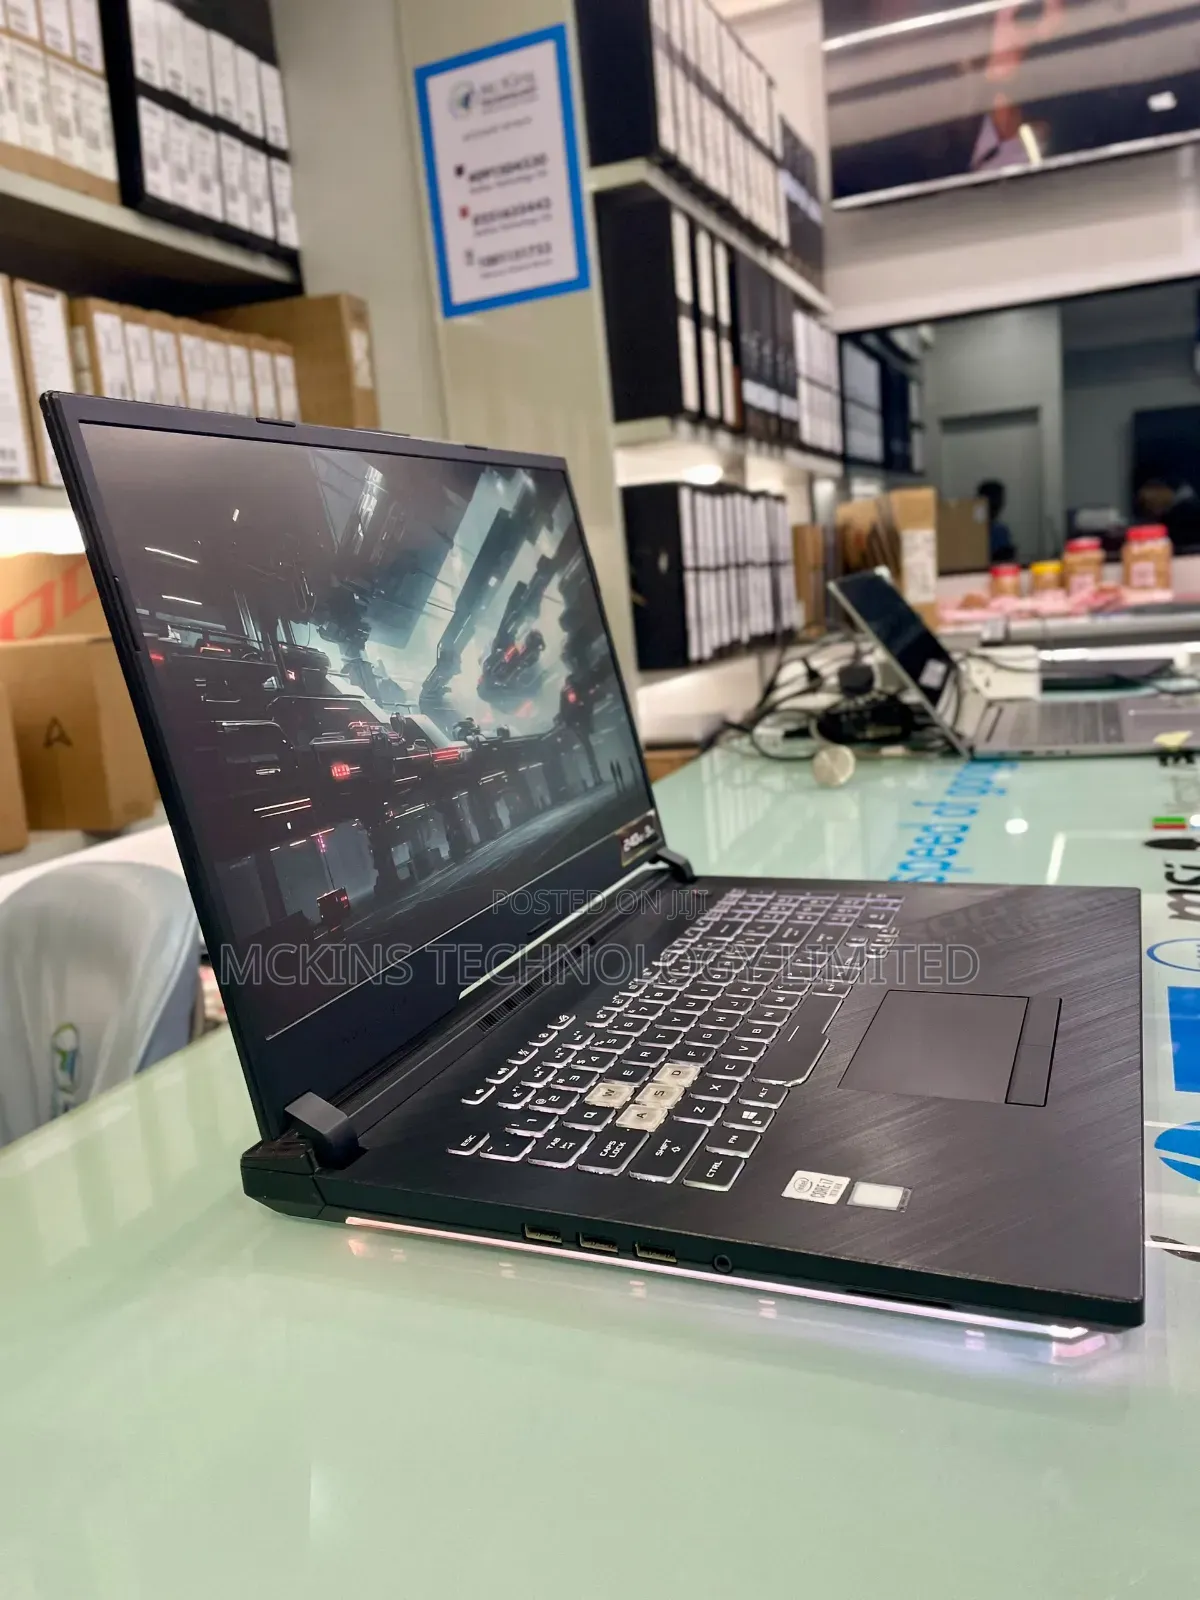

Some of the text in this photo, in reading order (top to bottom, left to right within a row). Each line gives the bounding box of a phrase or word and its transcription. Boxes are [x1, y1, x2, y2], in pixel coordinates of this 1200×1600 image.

[43, 716, 73, 748] A
[602, 1088, 615, 1097] W
[758, 1087, 769, 1098] ALT
[583, 1111, 598, 1119] Q
[693, 1105, 706, 1114] Z
[545, 1137, 561, 1150] TAB
[727, 1134, 739, 1144] FN
[599, 1140, 617, 1157] CAPS
[609, 1141, 627, 1158] LOCK
[655, 1138, 672, 1157] SHIFT
[706, 1160, 723, 1178] CTRL
